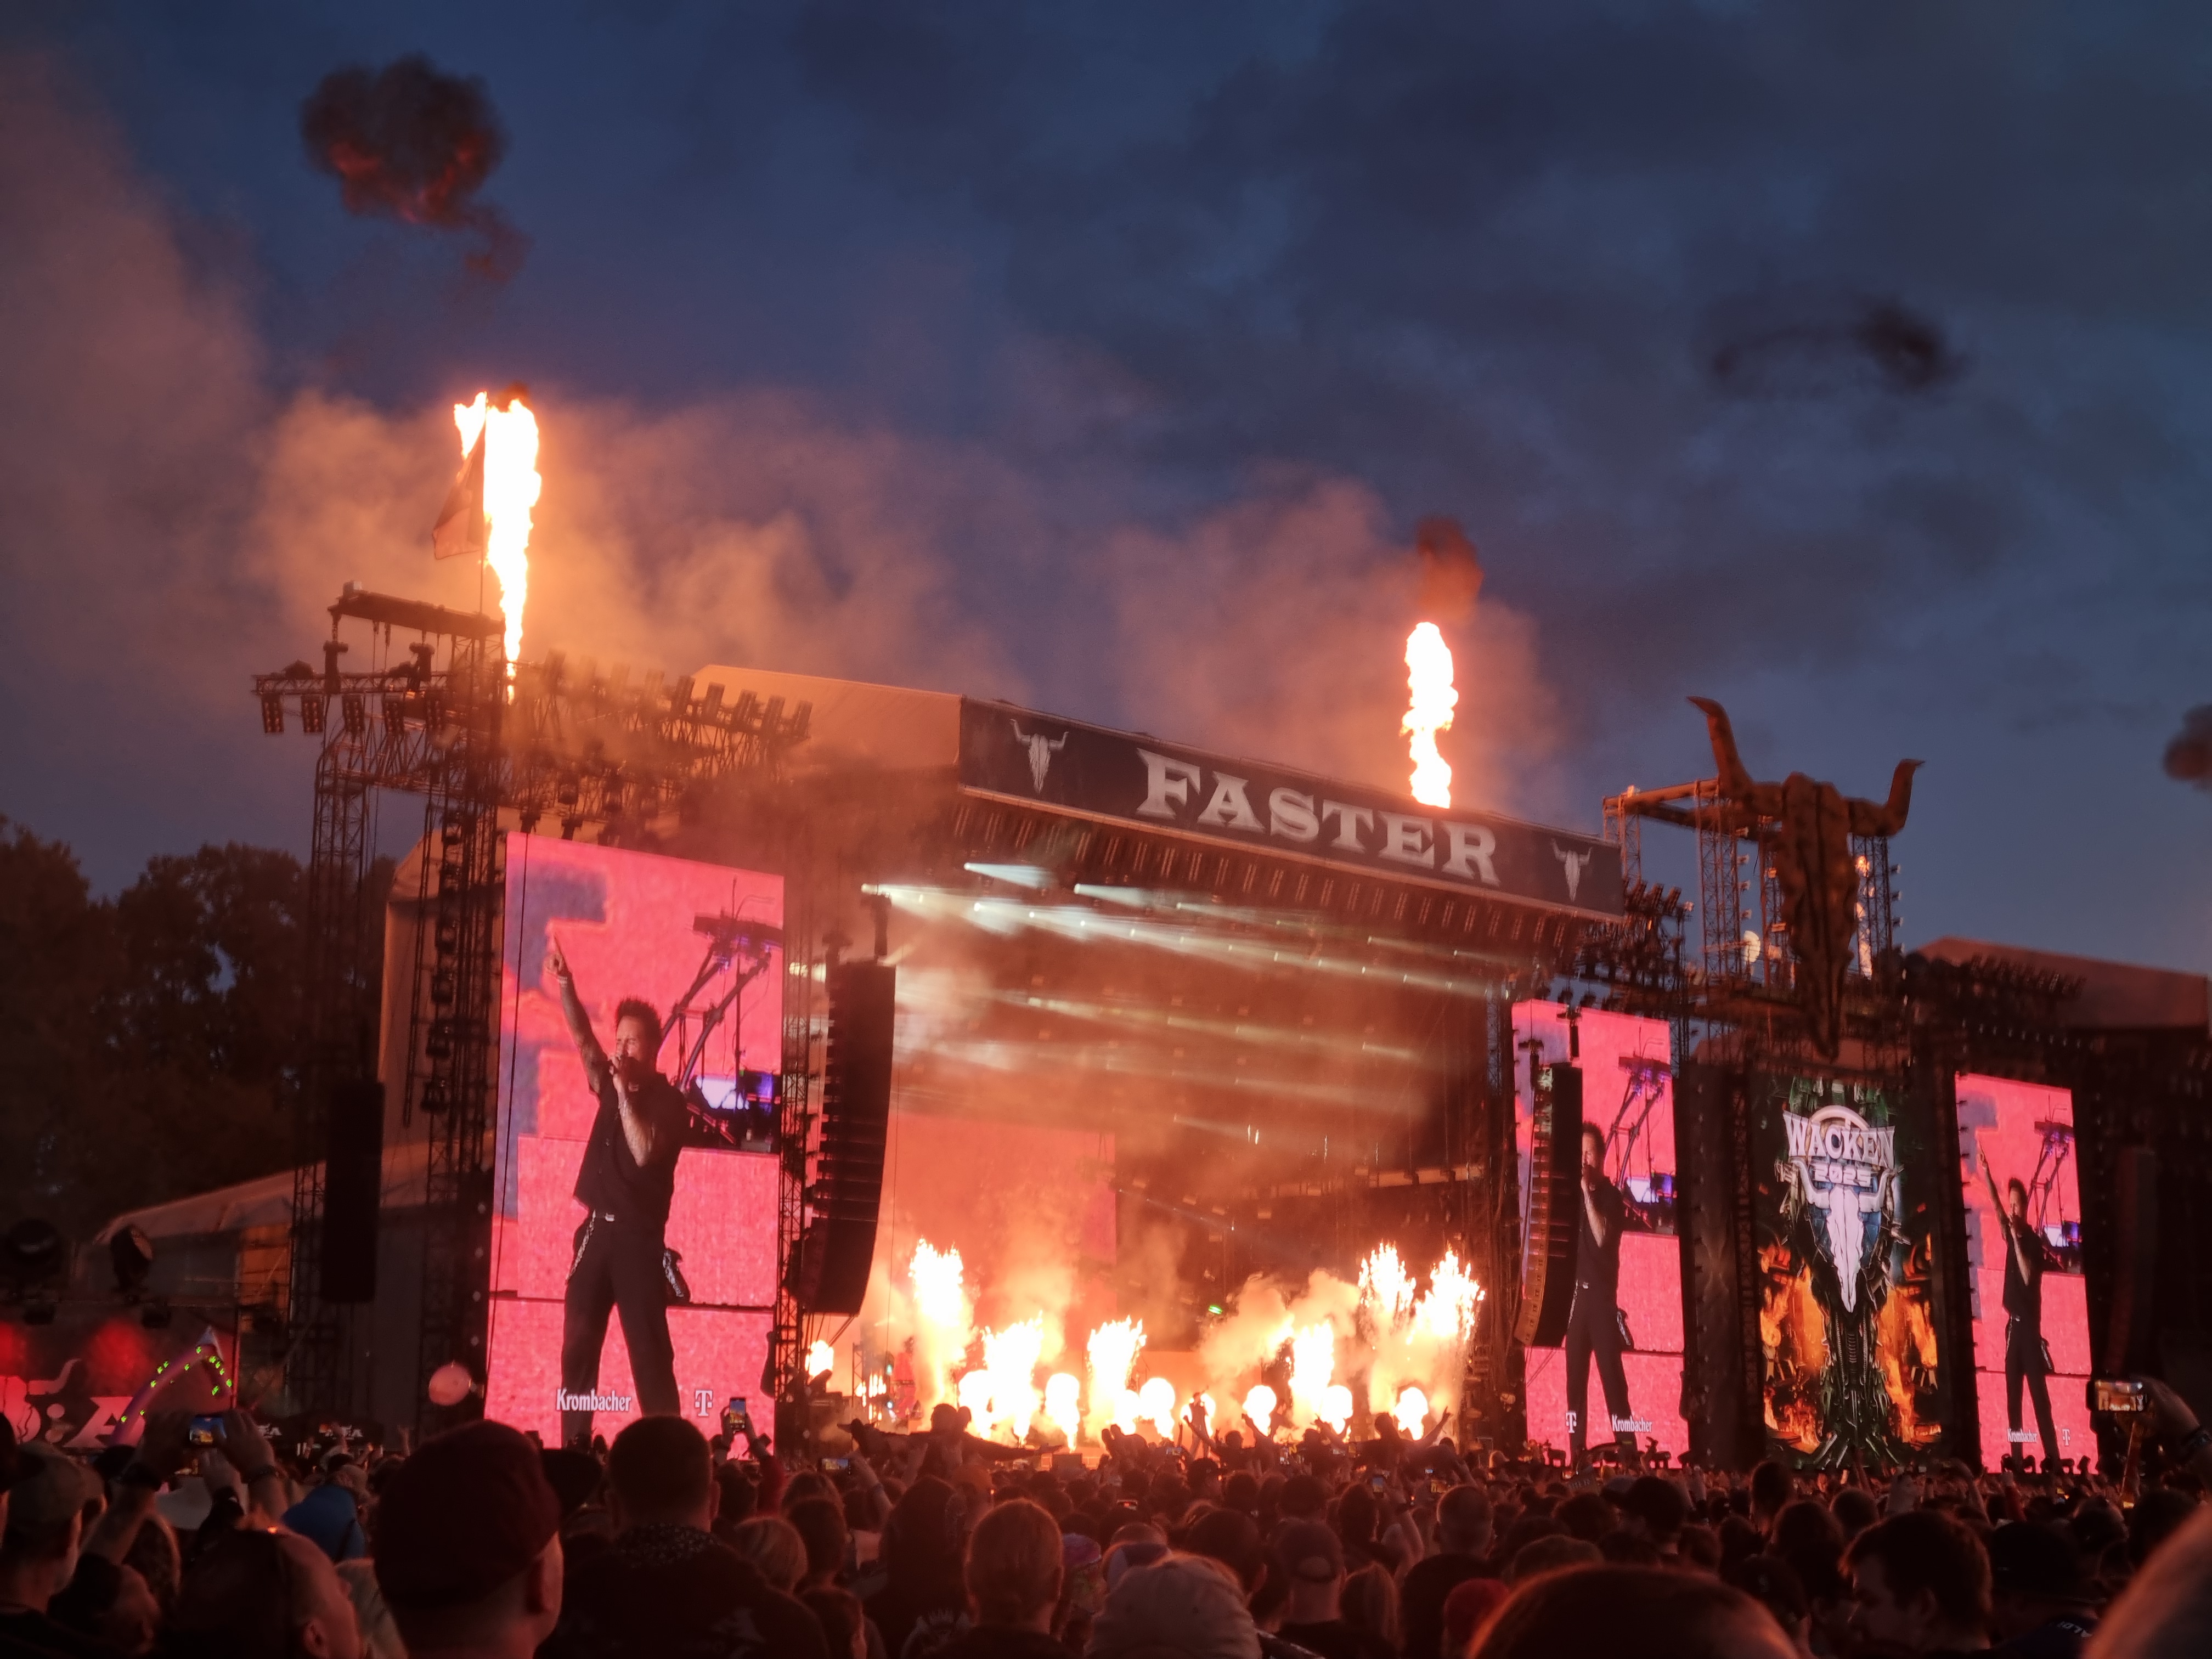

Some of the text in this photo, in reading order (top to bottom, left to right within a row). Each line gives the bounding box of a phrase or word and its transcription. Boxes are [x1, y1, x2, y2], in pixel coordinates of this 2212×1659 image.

[1136, 747, 1502, 886] FASTER
[1782, 1110, 1895, 1169] WACKEN
[1812, 1161, 1873, 1187] 2025
[556, 1387, 631, 1412] Krombacher
[695, 1390, 713, 1417] T
[1565, 1411, 1577, 1434] T
[1612, 1414, 1652, 1432] Krombacher
[2008, 1428, 2037, 1442] Krombacher
[2062, 1429, 2070, 1446] T
